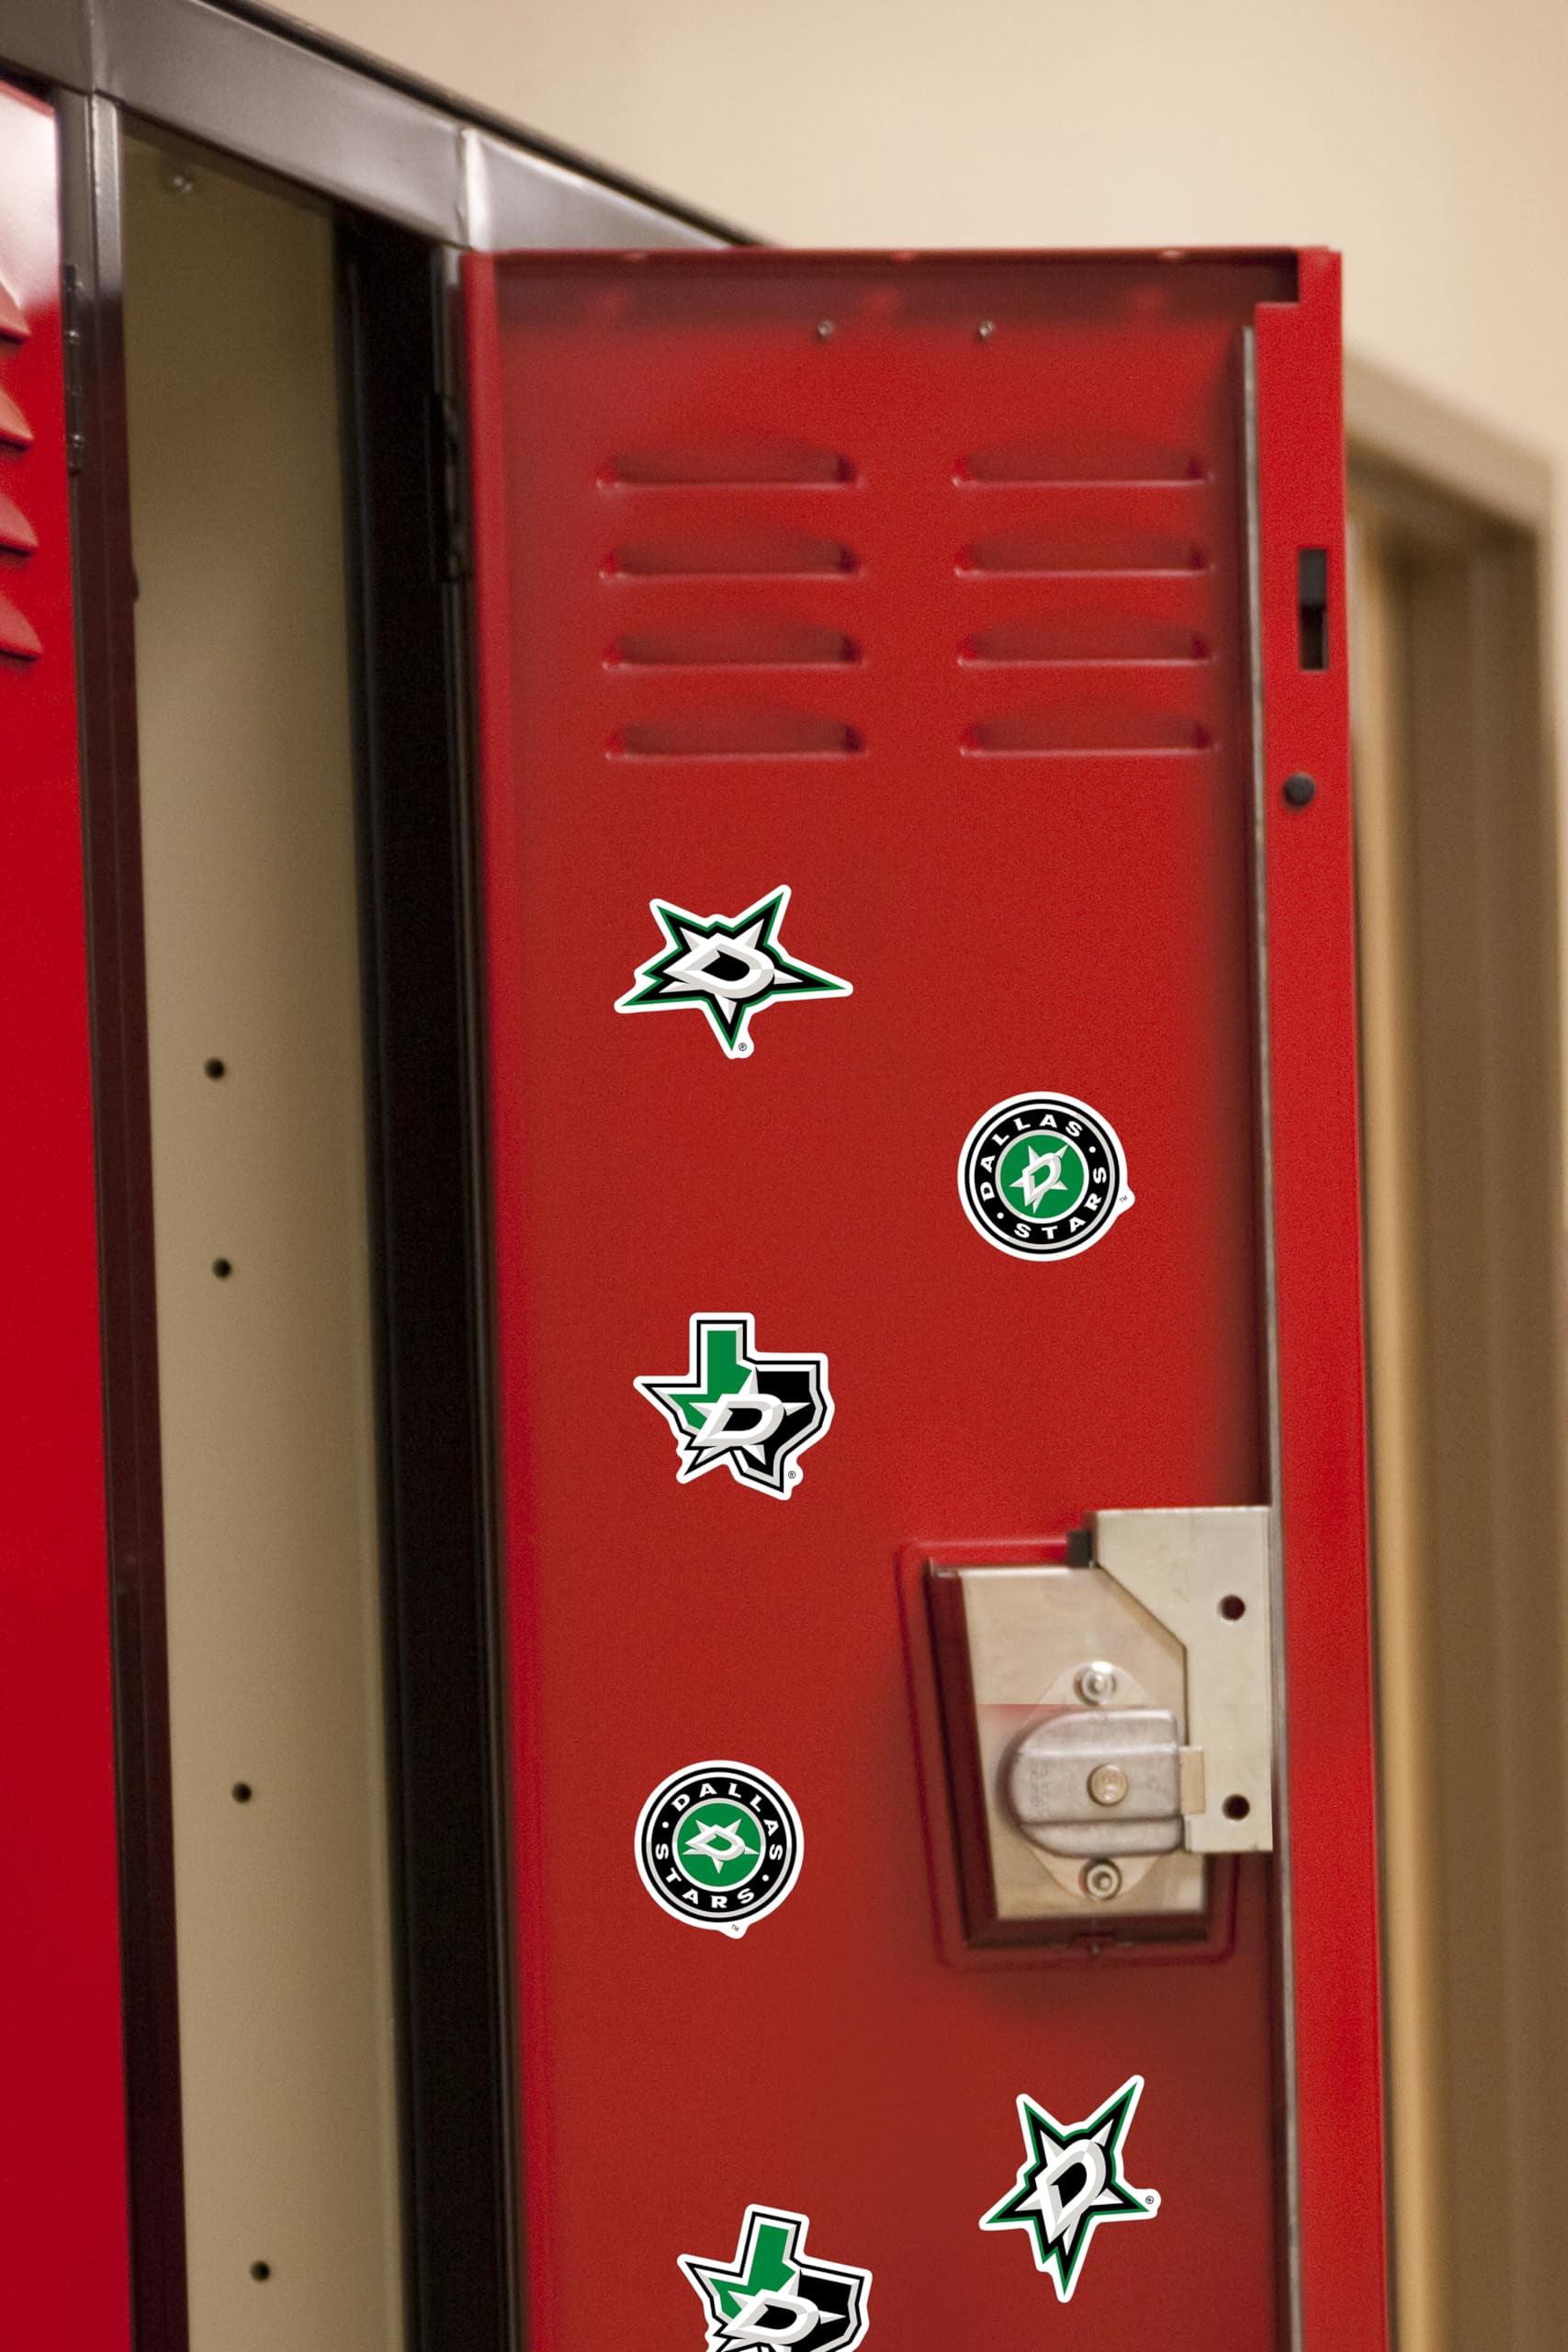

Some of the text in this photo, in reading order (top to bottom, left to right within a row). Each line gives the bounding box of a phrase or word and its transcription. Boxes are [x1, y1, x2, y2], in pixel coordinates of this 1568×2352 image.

[980, 1114, 1107, 1239] DALLAS STARS
[655, 1782, 784, 1908] DALLAS STARS
